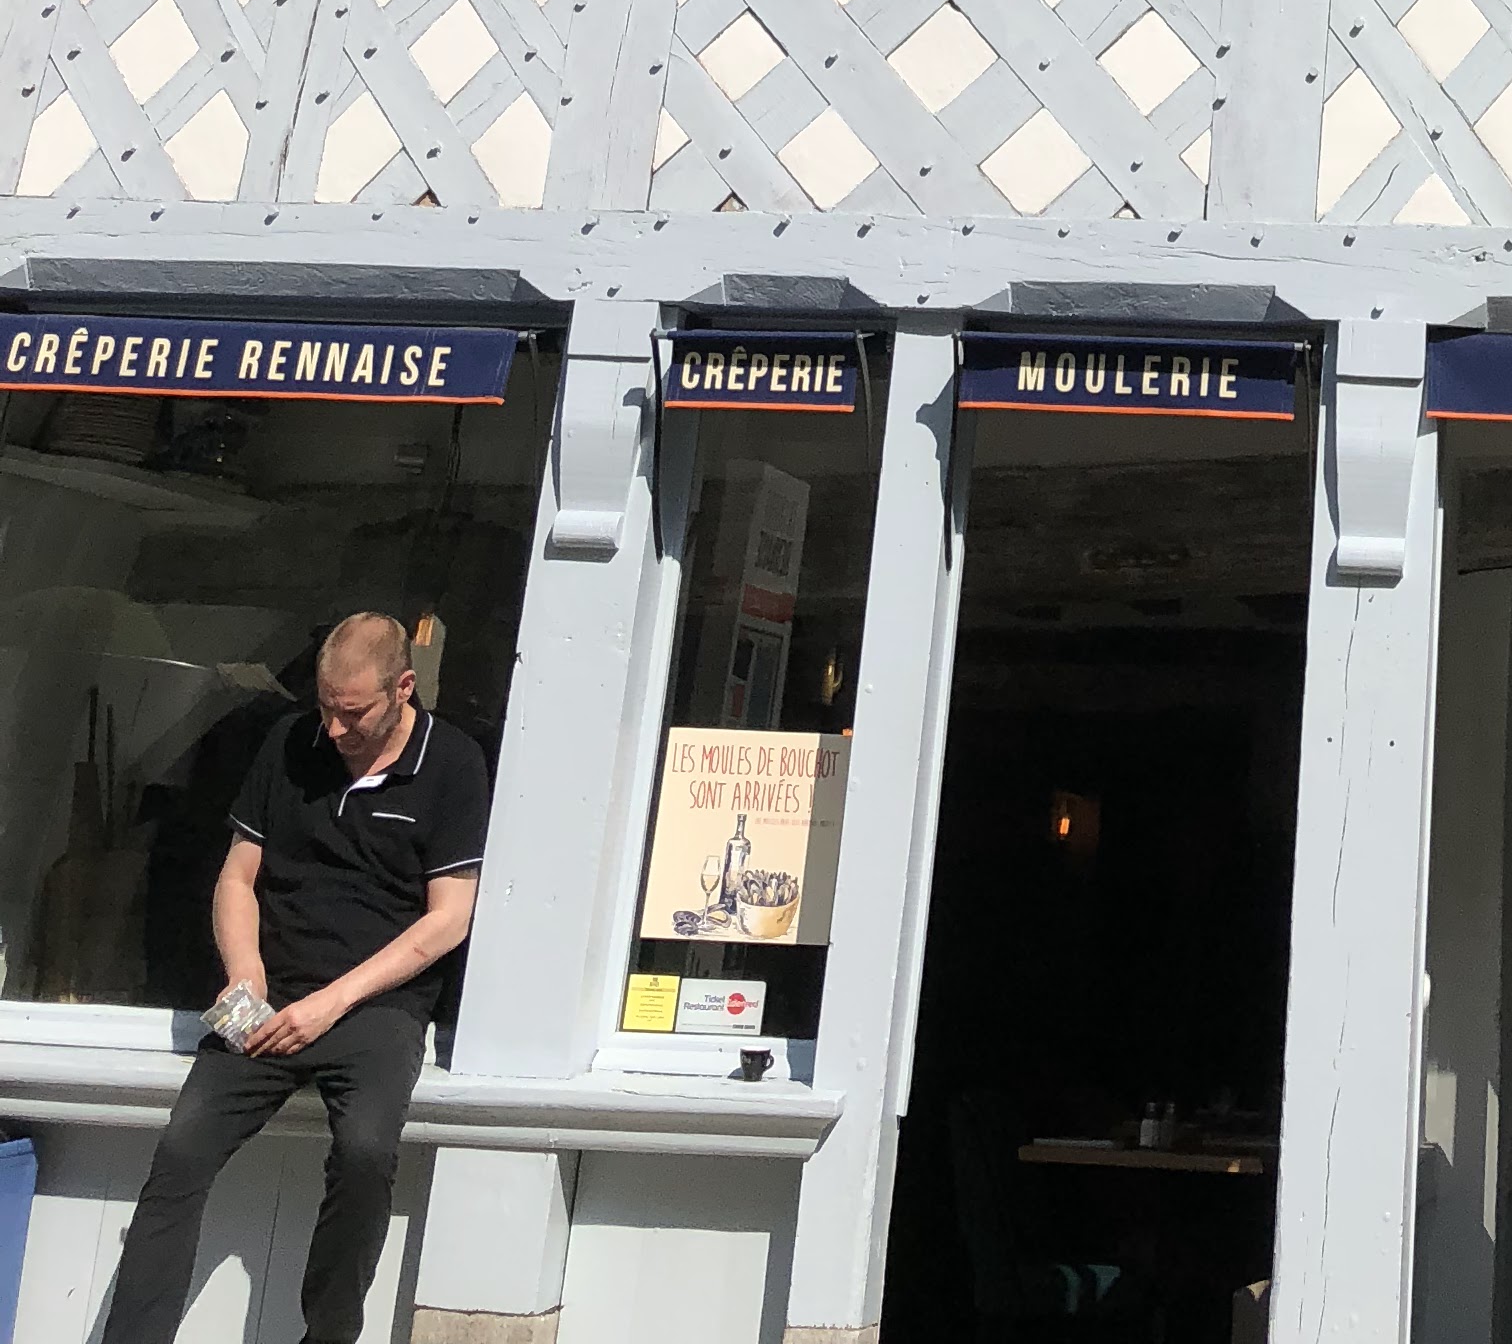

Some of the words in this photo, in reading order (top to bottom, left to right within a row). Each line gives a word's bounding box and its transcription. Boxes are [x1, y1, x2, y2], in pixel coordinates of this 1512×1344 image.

[6, 327, 219, 379] CRÊPERIE
[238, 339, 452, 387] RENNAISE
[680, 346, 846, 394] CRÊPERIE
[1017, 350, 1239, 399] MOULERIE
[671, 742, 696, 773] LES
[700, 744, 752, 776] MOULES
[756, 746, 775, 776] DE
[779, 746, 841, 779] BOUCHOT
[688, 779, 727, 810] SONT
[730, 778, 800, 814] ARRIVÉES
[807, 783, 814, 814] !
